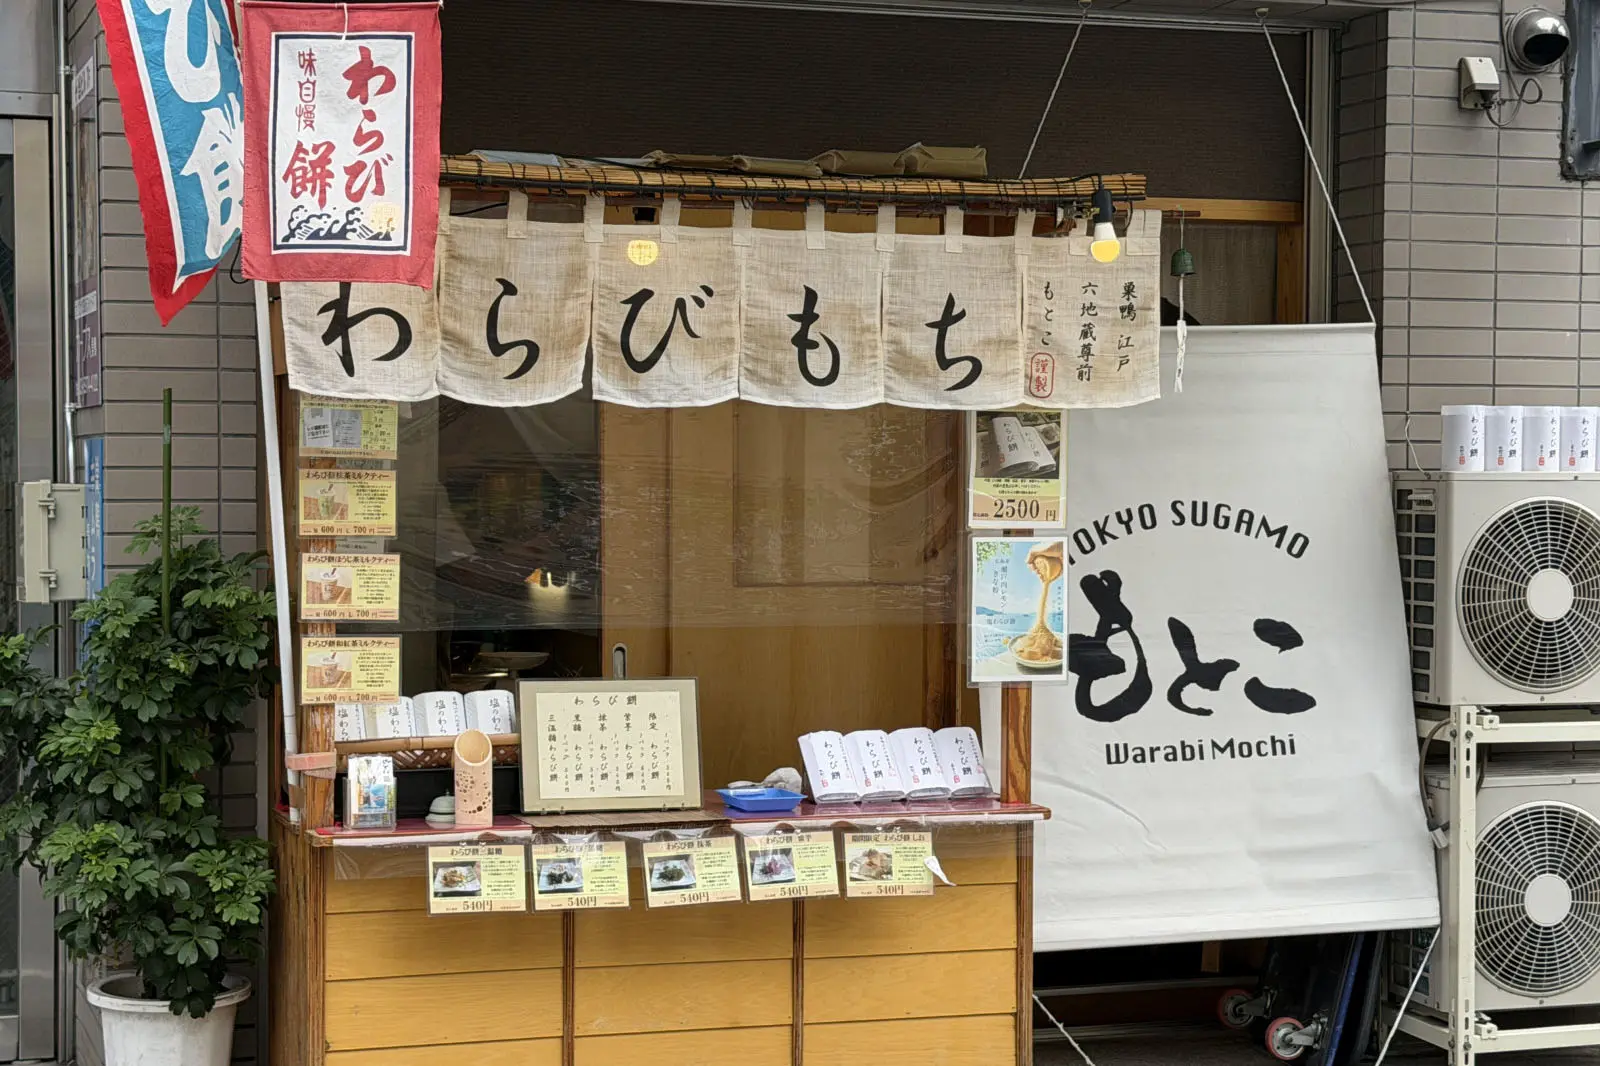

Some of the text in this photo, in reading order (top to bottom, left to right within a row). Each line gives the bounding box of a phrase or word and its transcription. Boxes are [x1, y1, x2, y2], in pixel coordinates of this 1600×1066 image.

[296, 47, 317, 132] 味自慢
[343, 45, 397, 203] わらび
[281, 139, 337, 210] 餅
[317, 278, 981, 391] わらびもち
[1041, 281, 1054, 346] もとこ
[1075, 281, 1099, 383] 六地蔵尊前
[1117, 281, 1137, 373] 巣鴨 江戸
[1069, 499, 1310, 566] OKYO SUGAMO
[1069, 570, 1317, 722] もとこ
[1105, 733, 1296, 765] Warabi Mochi
